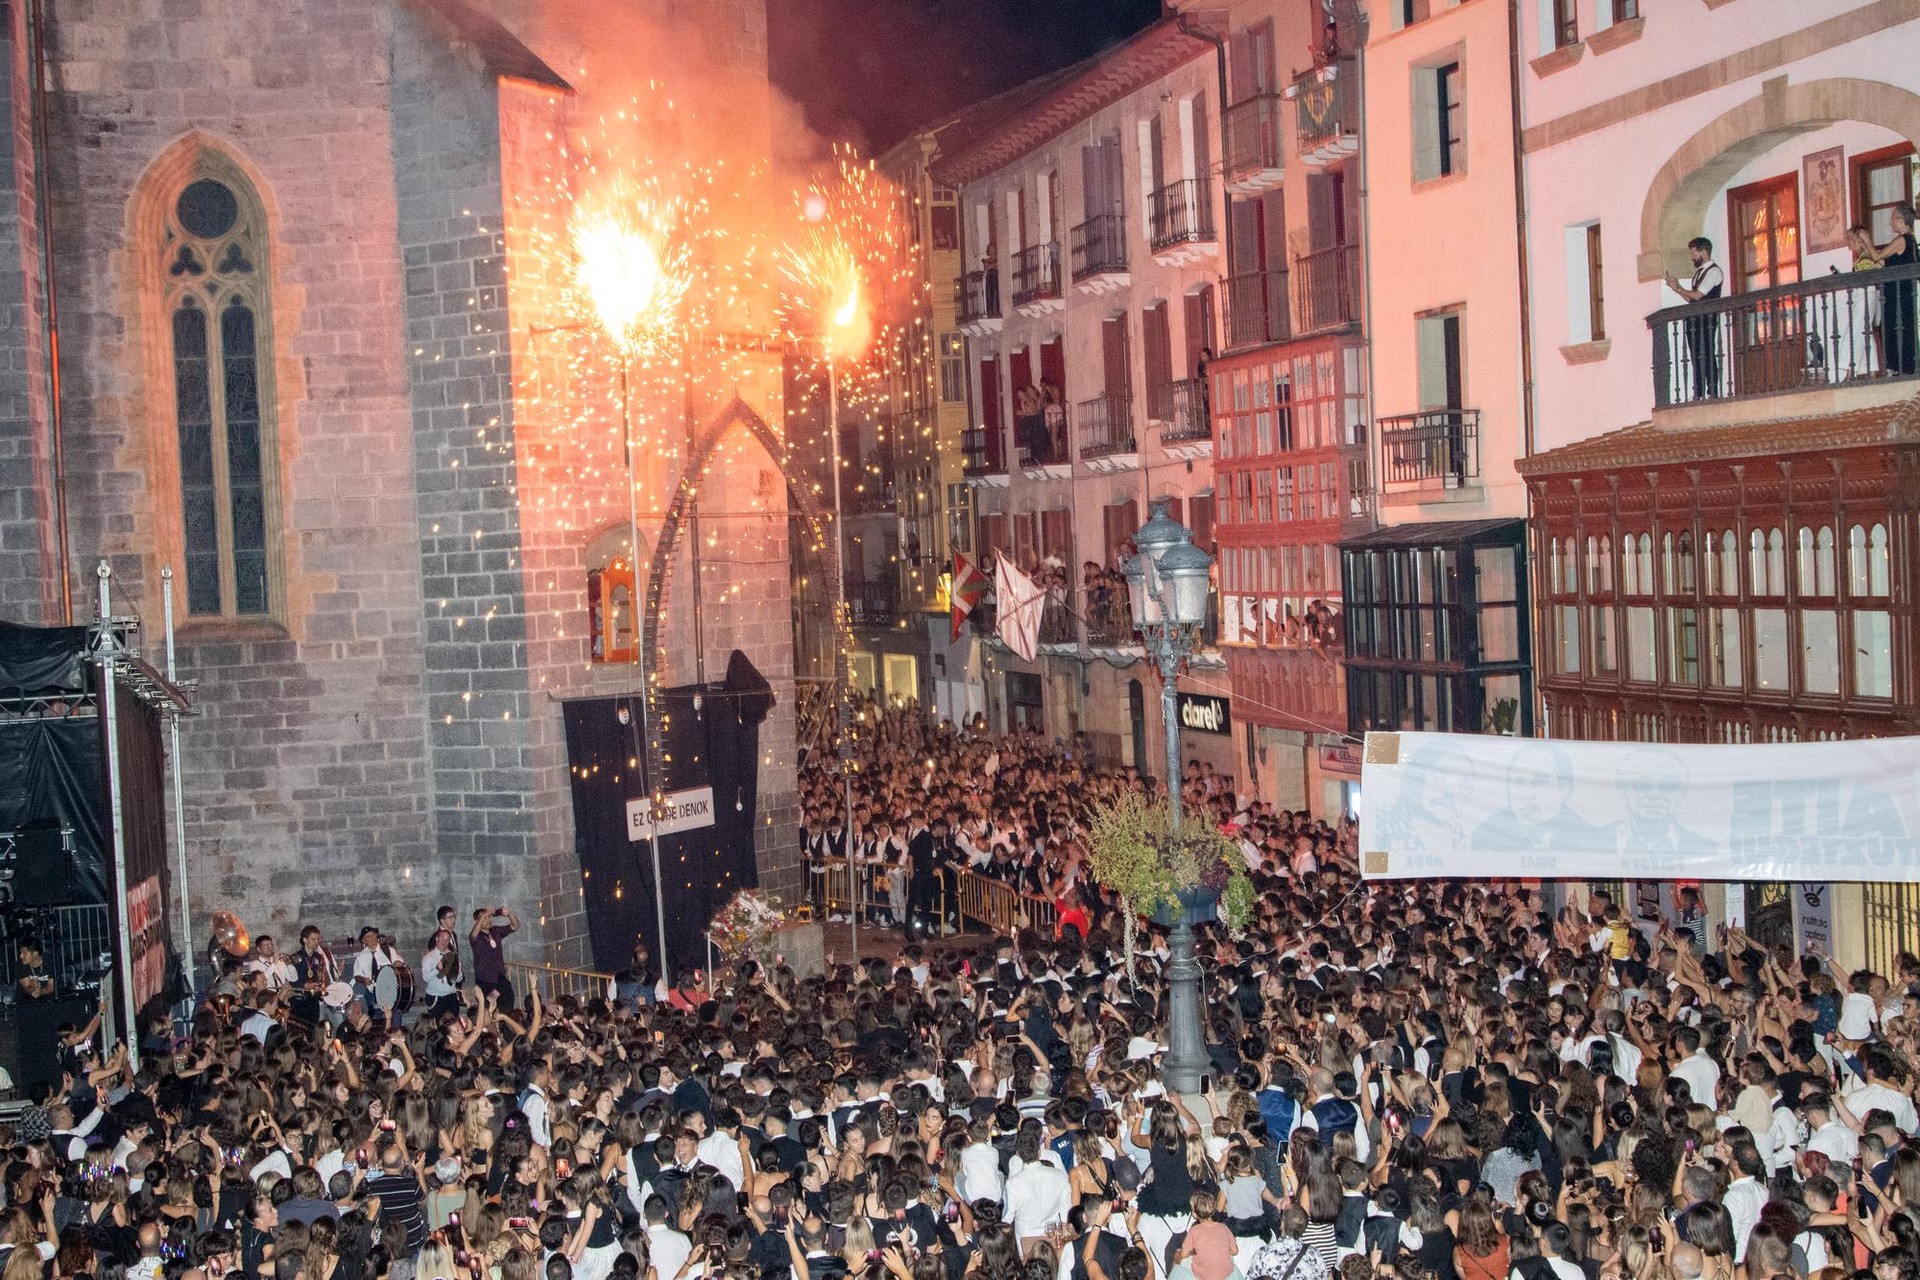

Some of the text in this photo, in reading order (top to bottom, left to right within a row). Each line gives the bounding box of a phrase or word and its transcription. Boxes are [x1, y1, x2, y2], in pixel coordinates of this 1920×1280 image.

[1182, 696, 1219, 733] clarel
[633, 812, 645, 828] EZ
[679, 800, 710, 818] DENOK
